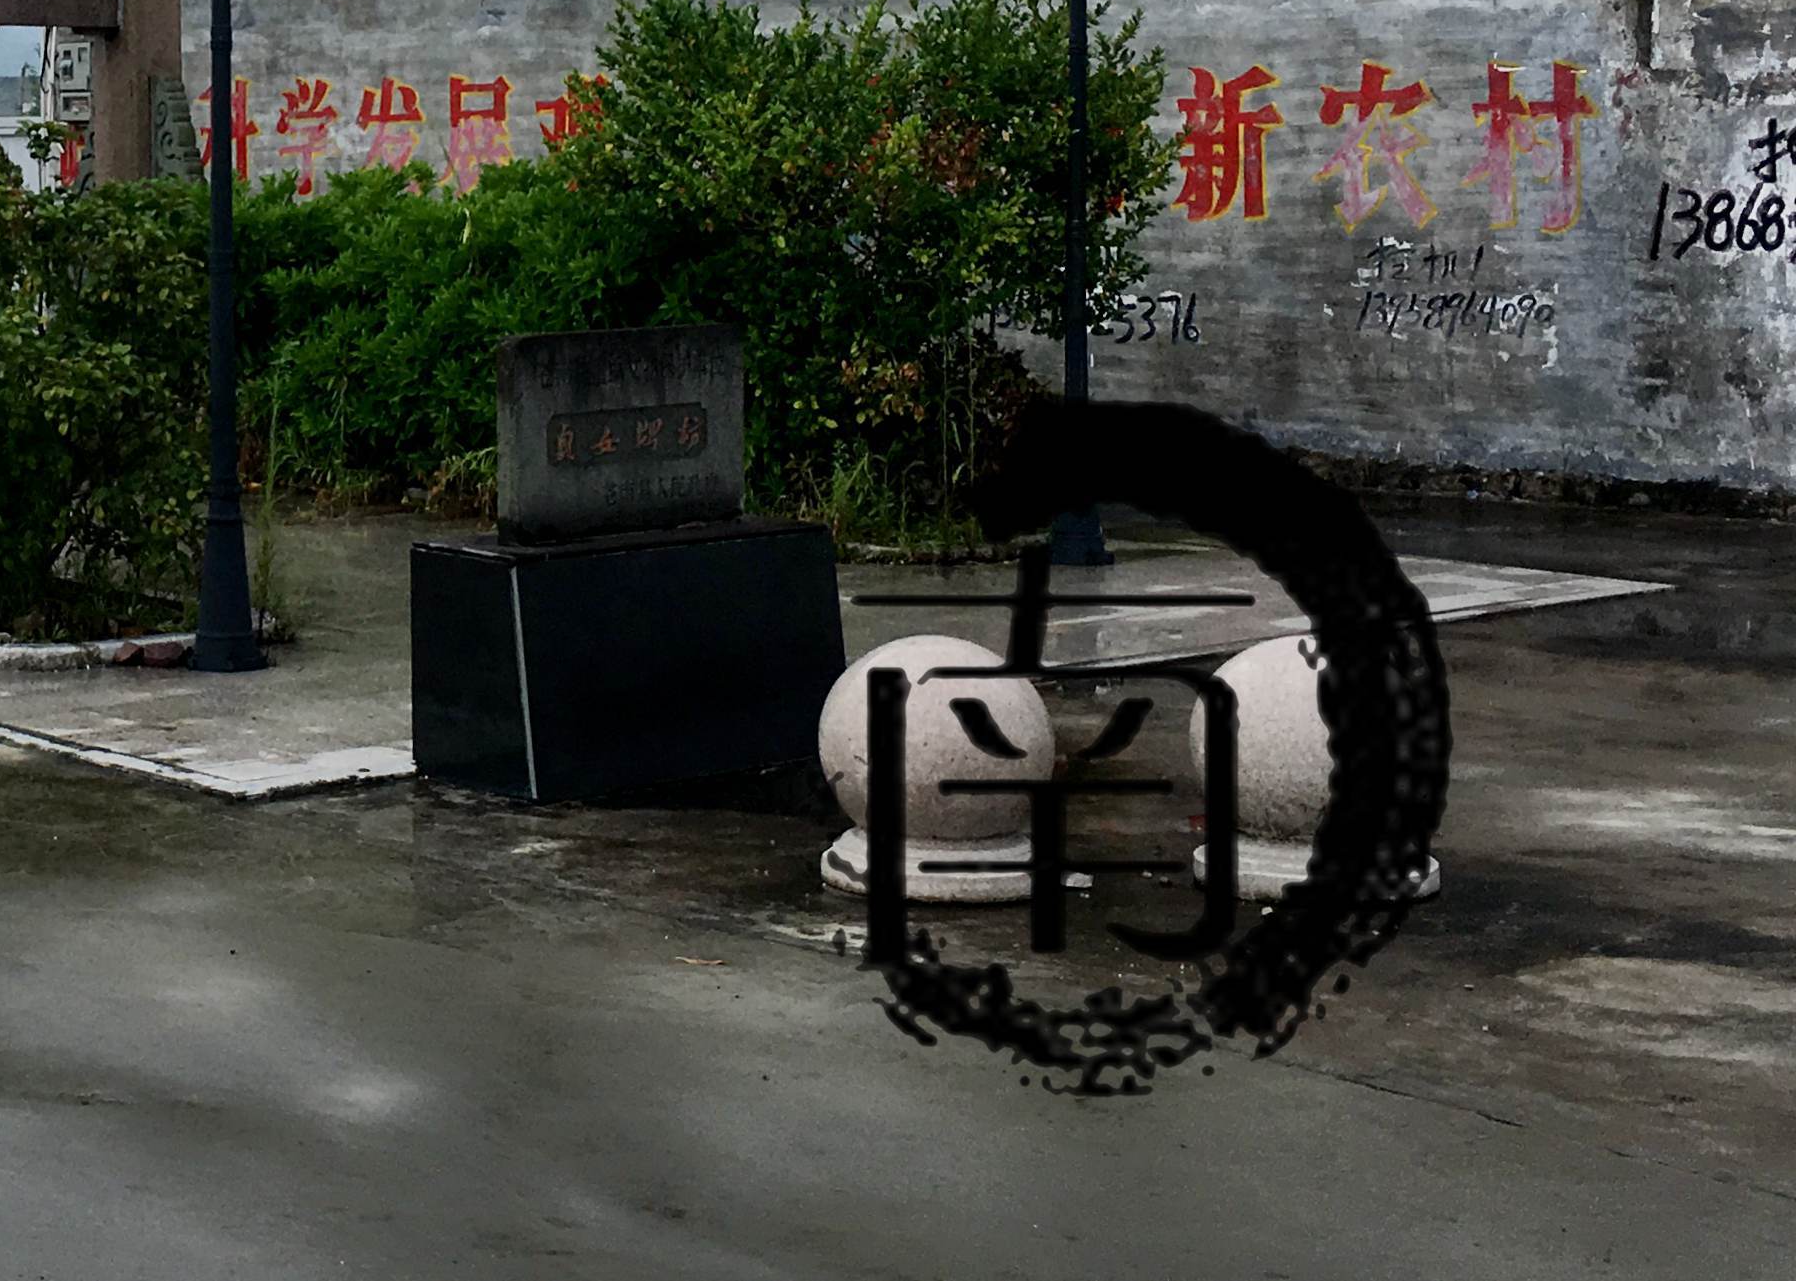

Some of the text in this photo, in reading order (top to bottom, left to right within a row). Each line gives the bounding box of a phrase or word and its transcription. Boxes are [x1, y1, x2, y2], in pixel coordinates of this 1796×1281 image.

[1172, 60, 1600, 234] 新农村
[1650, 181, 1795, 261] 13868
